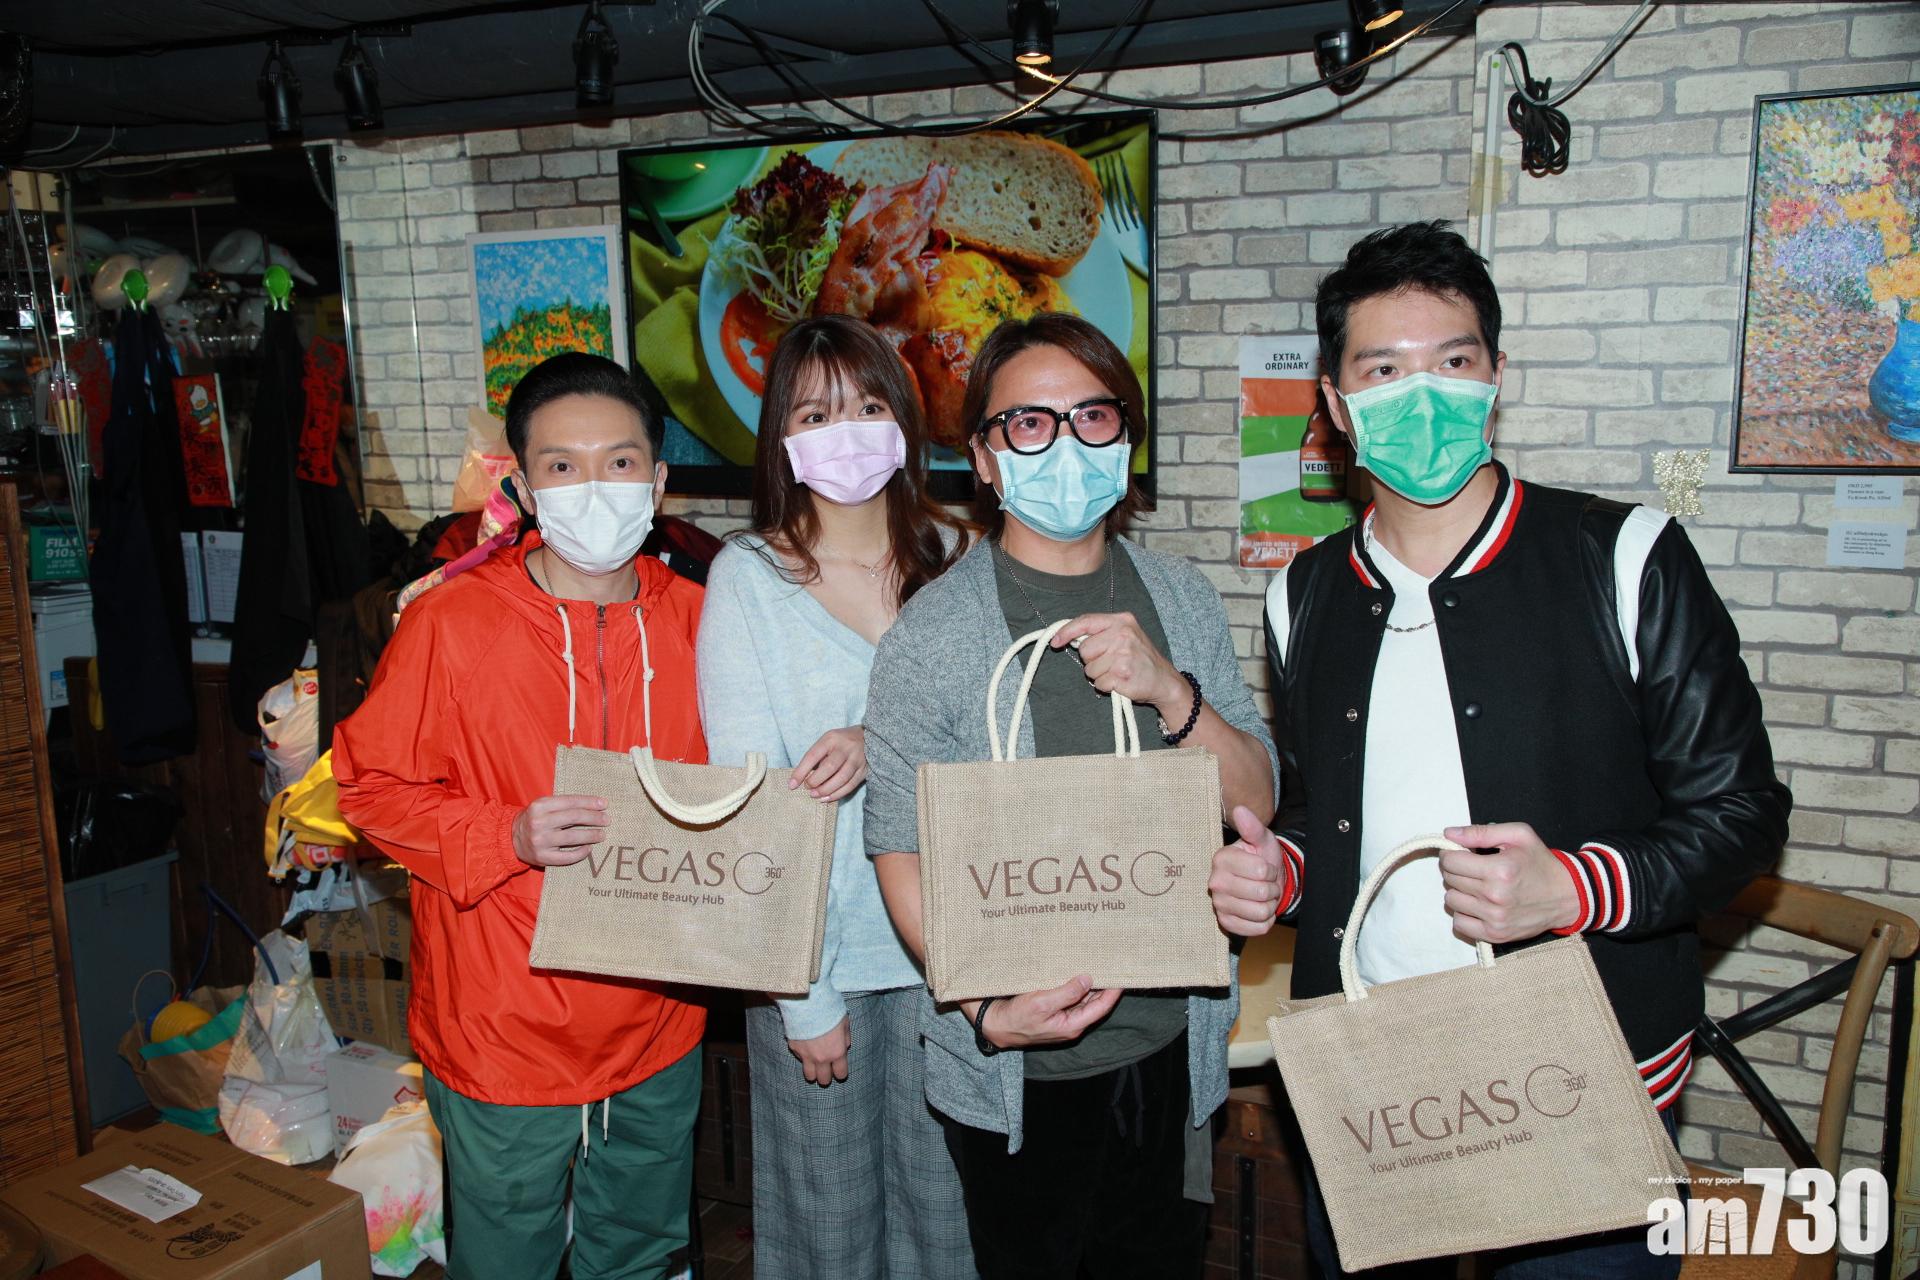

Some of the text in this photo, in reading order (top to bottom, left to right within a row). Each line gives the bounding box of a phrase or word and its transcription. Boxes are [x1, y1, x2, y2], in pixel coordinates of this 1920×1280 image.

[1265, 362, 1310, 371] ORDINARY
[1273, 353, 1301, 362] EXTRA
[1254, 547, 1297, 560] VEDETT
[586, 845, 726, 887] VEGAS
[967, 854, 1123, 900] VEGAS
[588, 886, 726, 906] Your Ultimate Beauty Hub
[980, 899, 1126, 920] Your Ultimate Beauty Hub
[1341, 1079, 1521, 1154] VEGAS
[1368, 1130, 1534, 1175] Your Ultimate Beauty Hub
